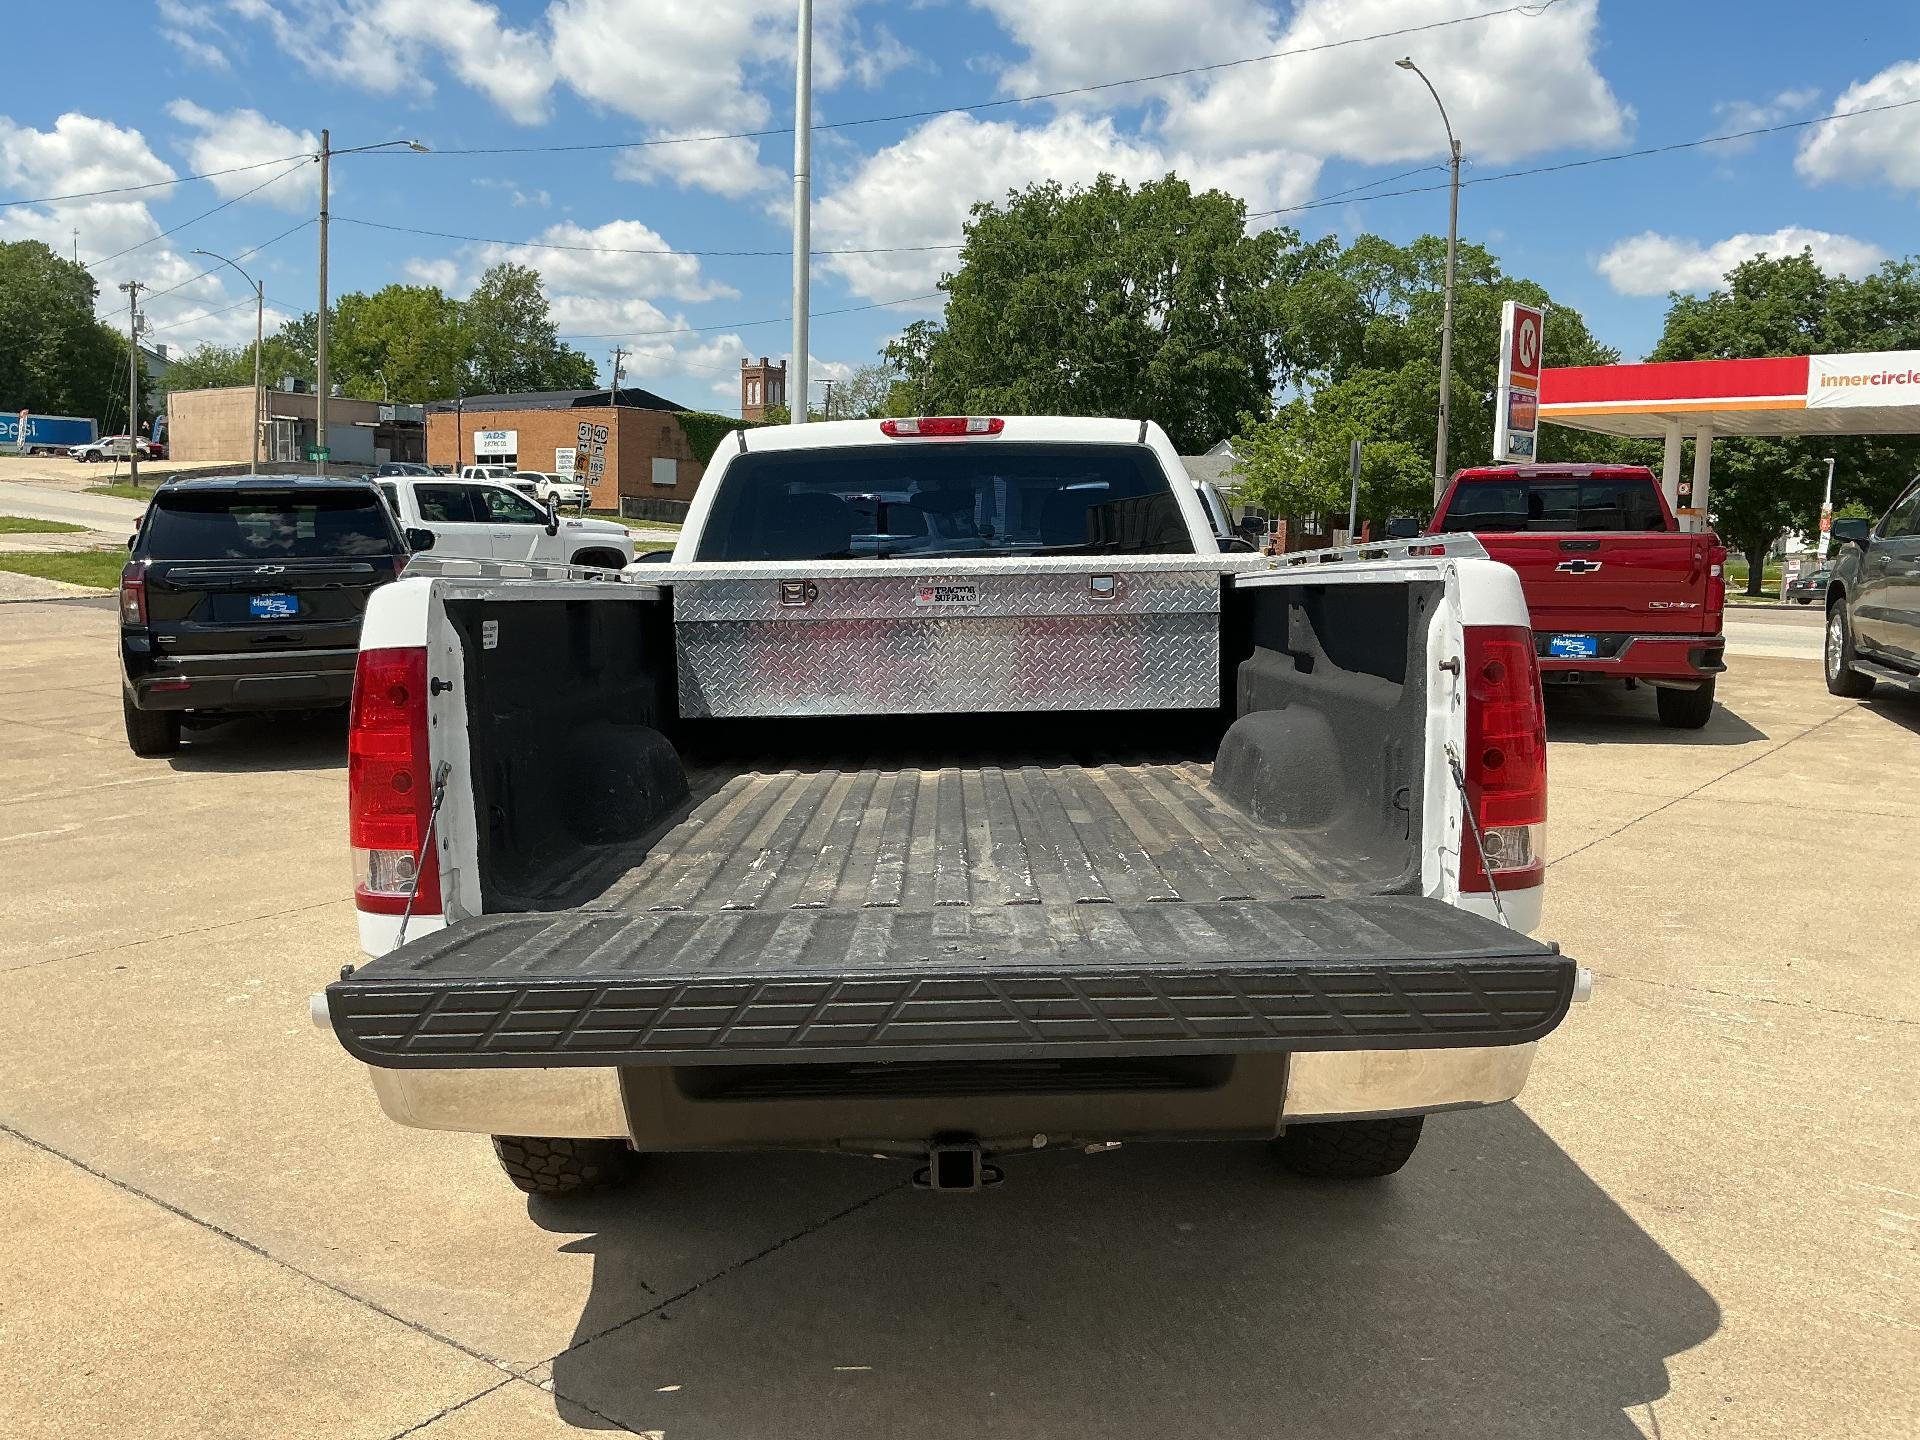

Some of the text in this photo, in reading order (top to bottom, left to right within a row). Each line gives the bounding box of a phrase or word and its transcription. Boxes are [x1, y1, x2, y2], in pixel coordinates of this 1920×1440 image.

[1523, 328, 1534, 361] K
[1820, 369, 1920, 387] innercircle
[486, 431, 507, 440] ADS
[580, 425, 590, 436] 51
[594, 429, 607, 440] 40
[590, 462, 604, 472] 185
[935, 586, 976, 595] TRACTOR
[935, 594, 965, 602] SUPPLY
